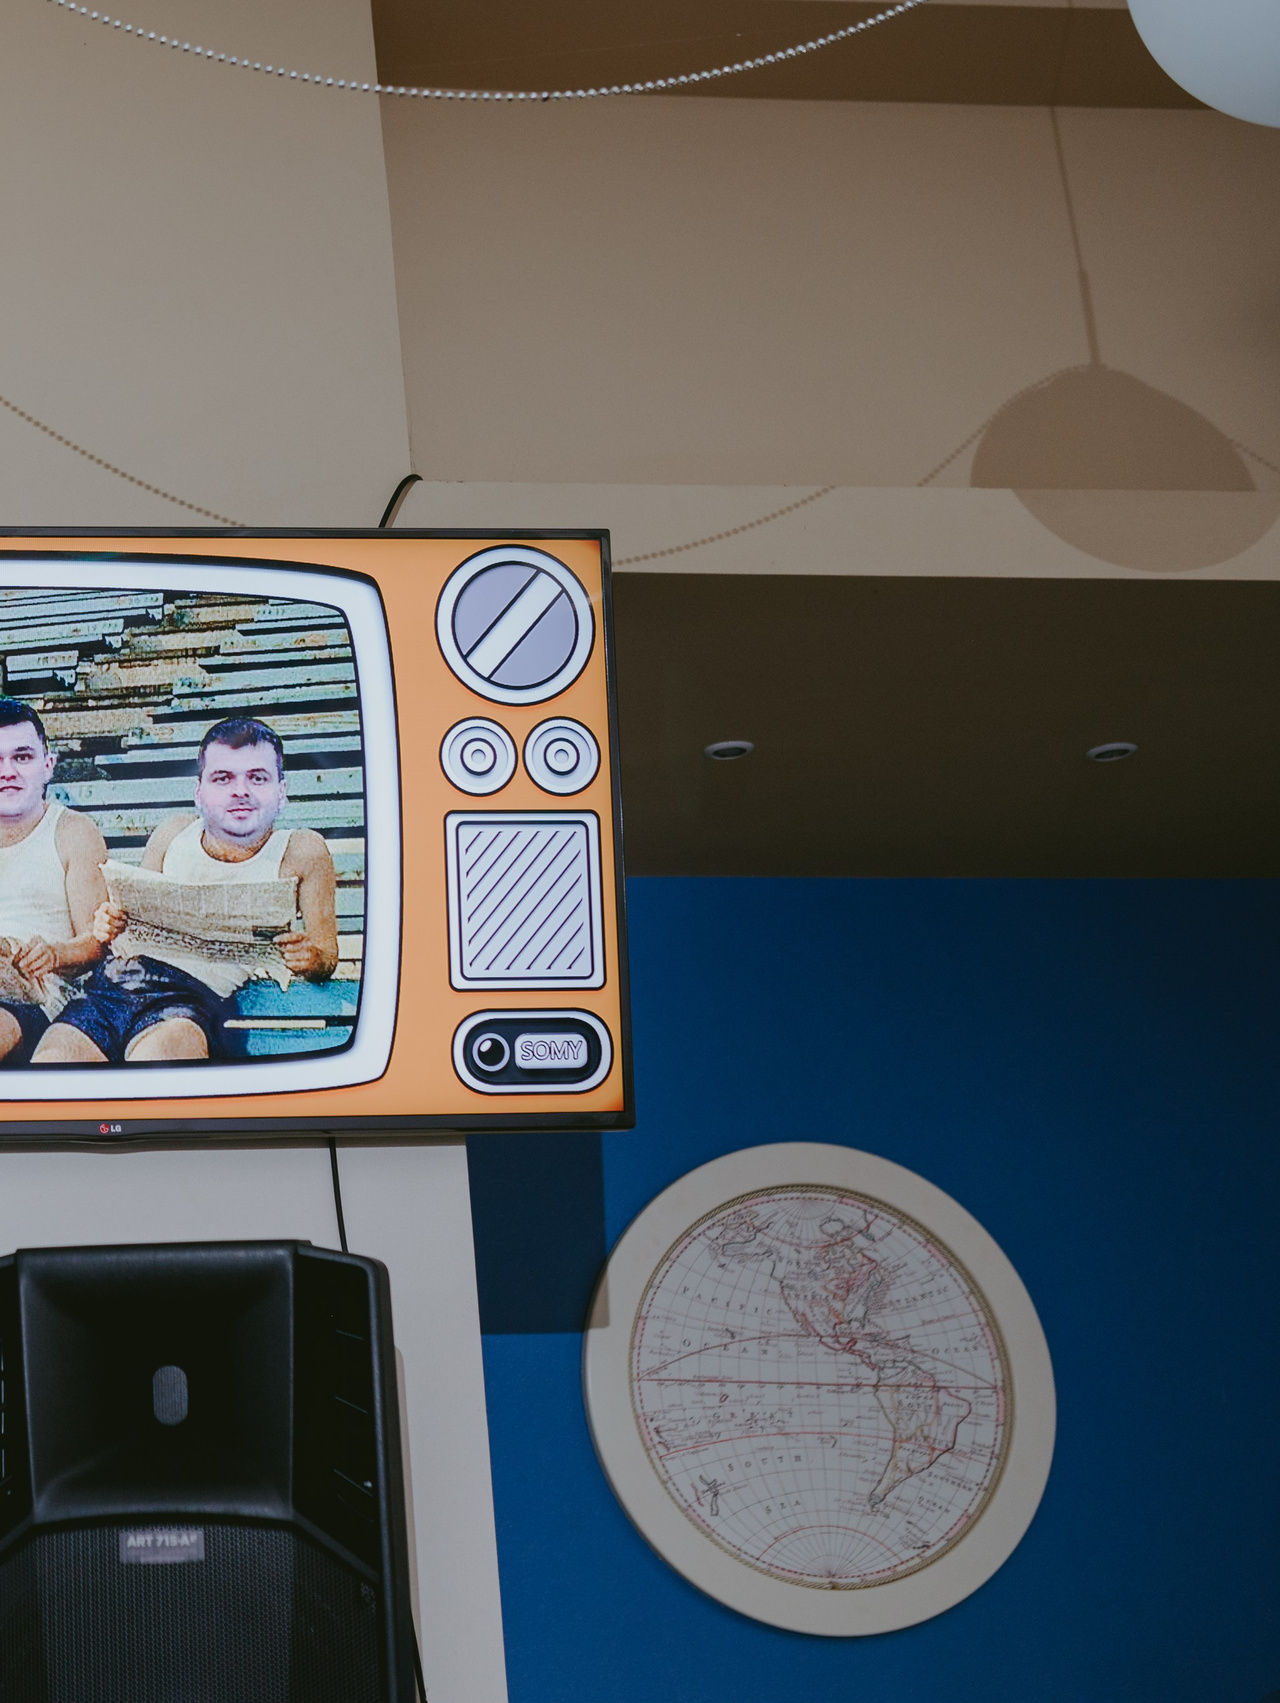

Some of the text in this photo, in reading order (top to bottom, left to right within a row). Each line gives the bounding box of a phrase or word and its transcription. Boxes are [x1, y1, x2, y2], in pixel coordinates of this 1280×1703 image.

[520, 1040, 582, 1061] SOMY
[110, 1124, 122, 1133] LG
[127, 1533, 153, 1548] ART
